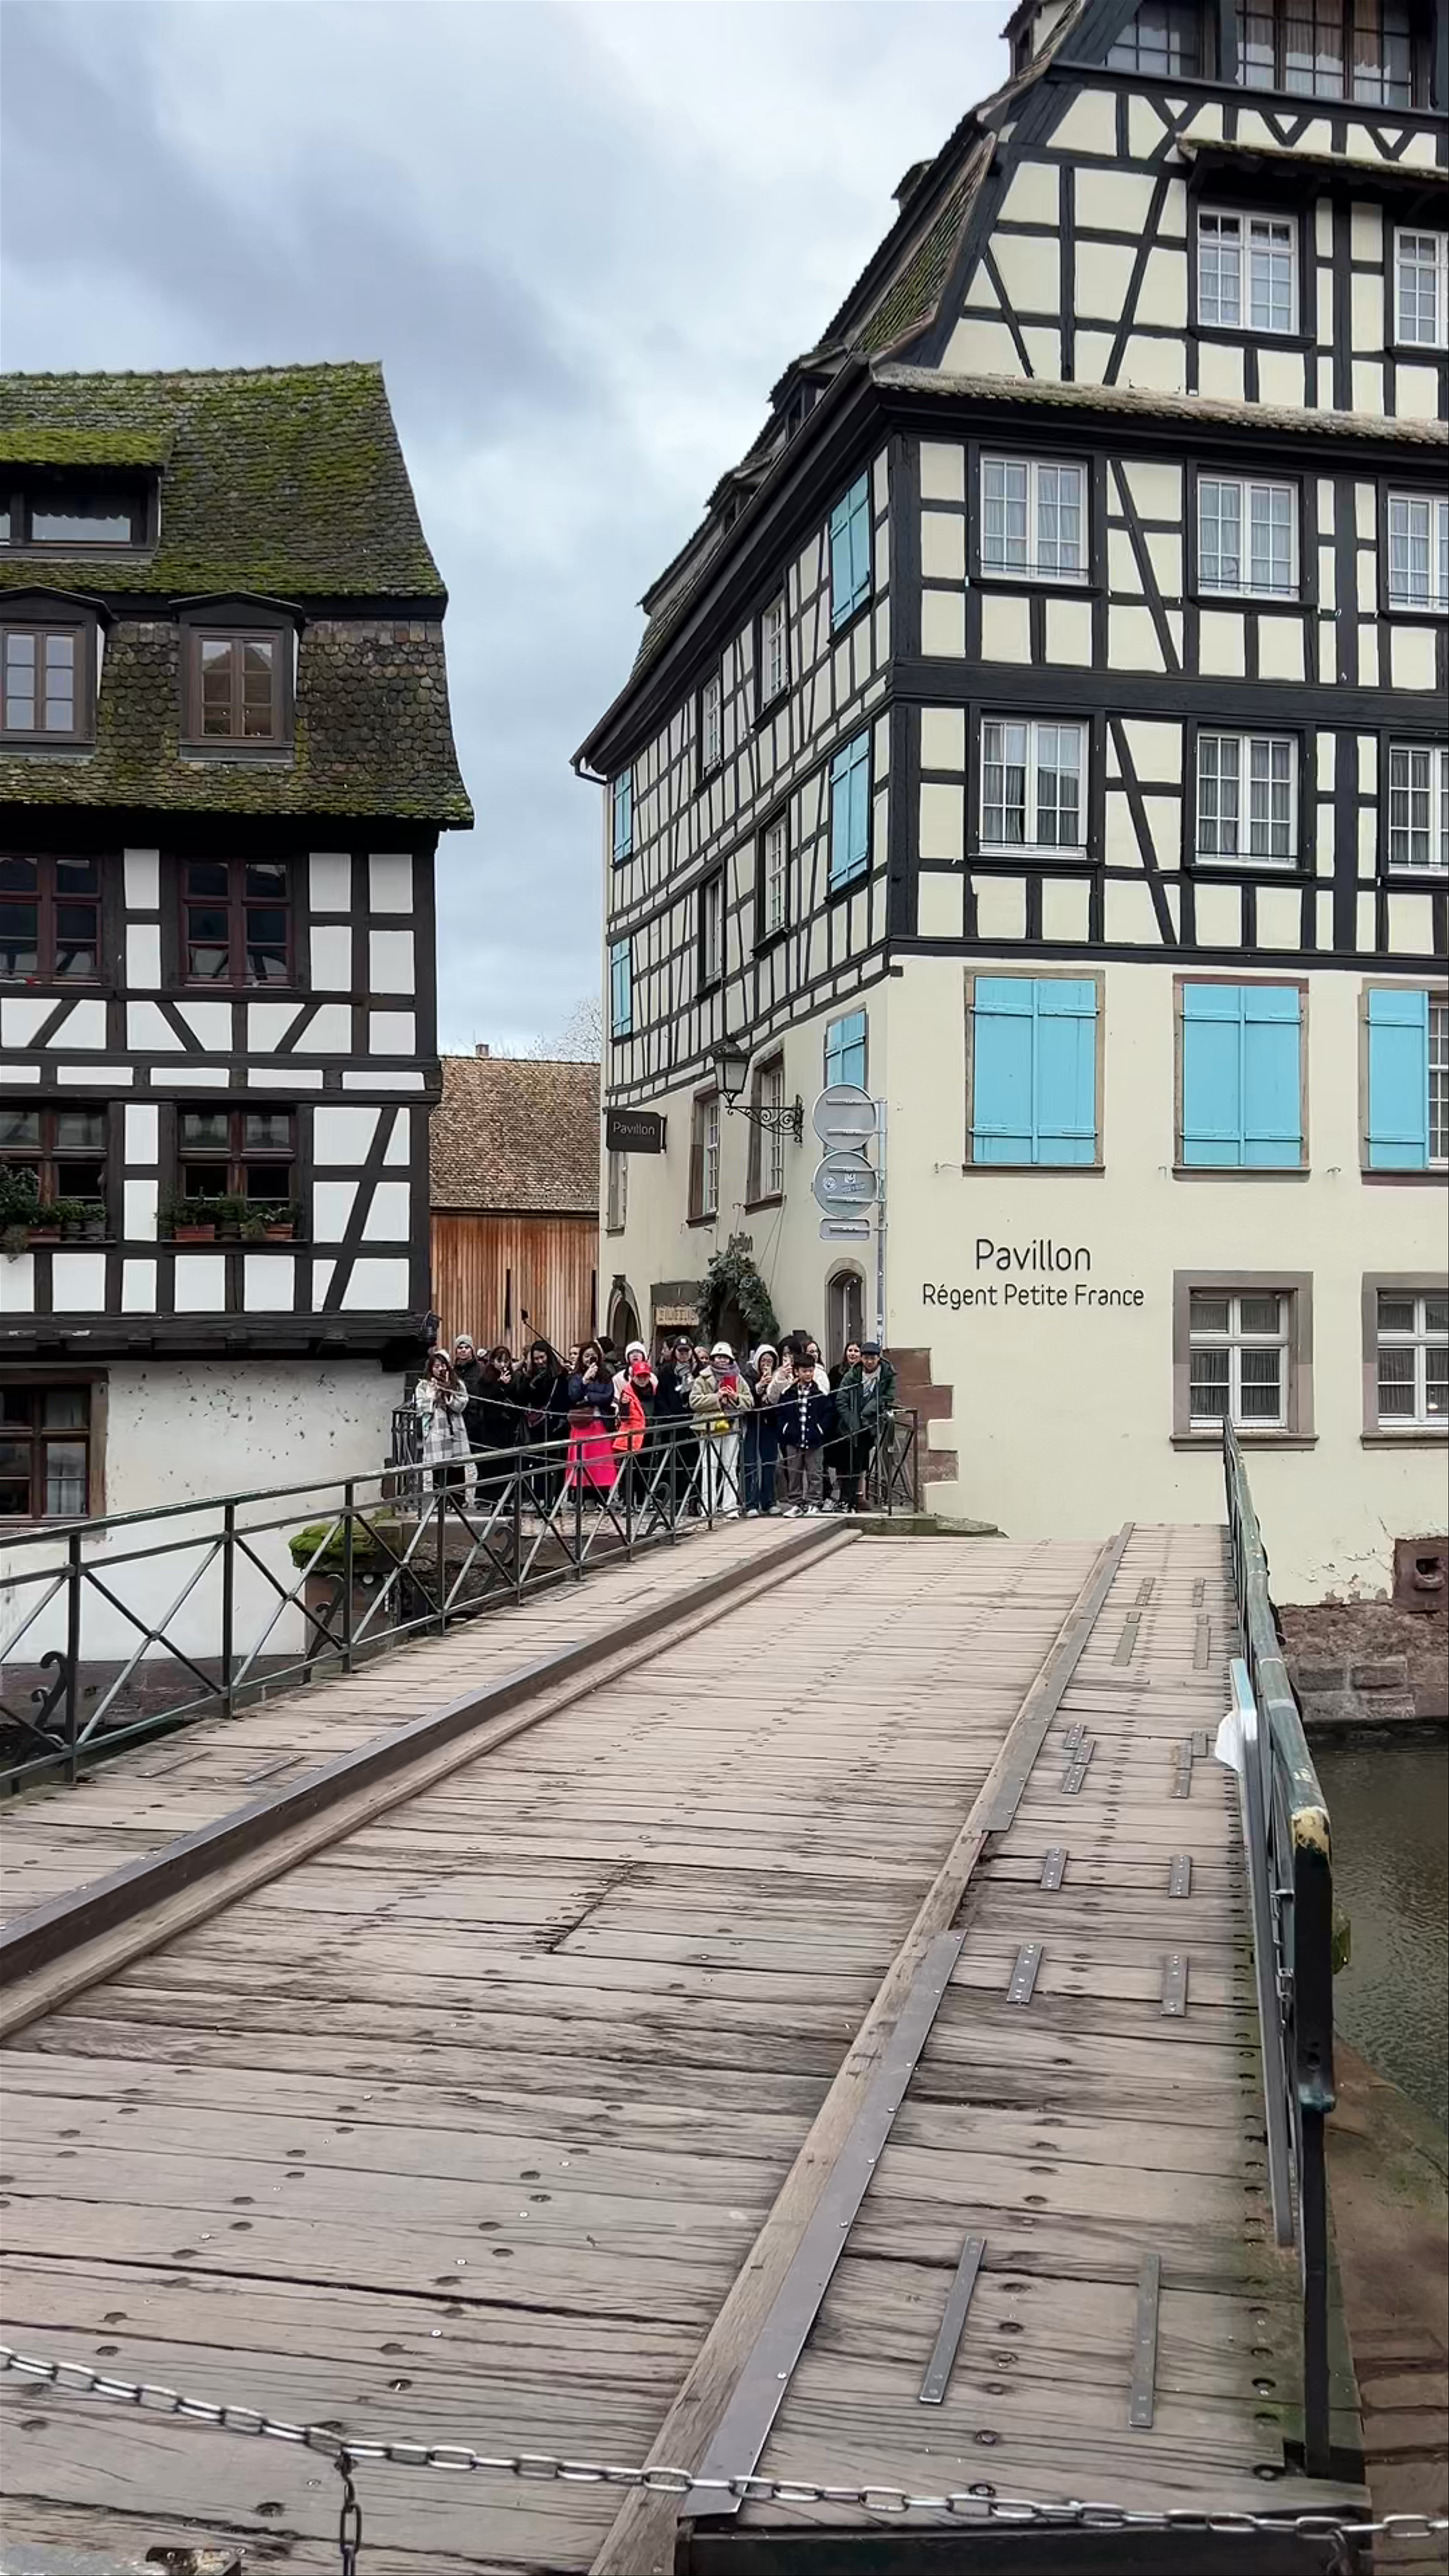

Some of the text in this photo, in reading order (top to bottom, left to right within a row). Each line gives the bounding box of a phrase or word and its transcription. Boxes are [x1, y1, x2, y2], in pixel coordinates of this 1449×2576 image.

[613, 1121, 655, 1135] Pavillon
[977, 1239, 1091, 1271] Pavillon
[923, 1283, 1144, 1310] Régent Petite France
